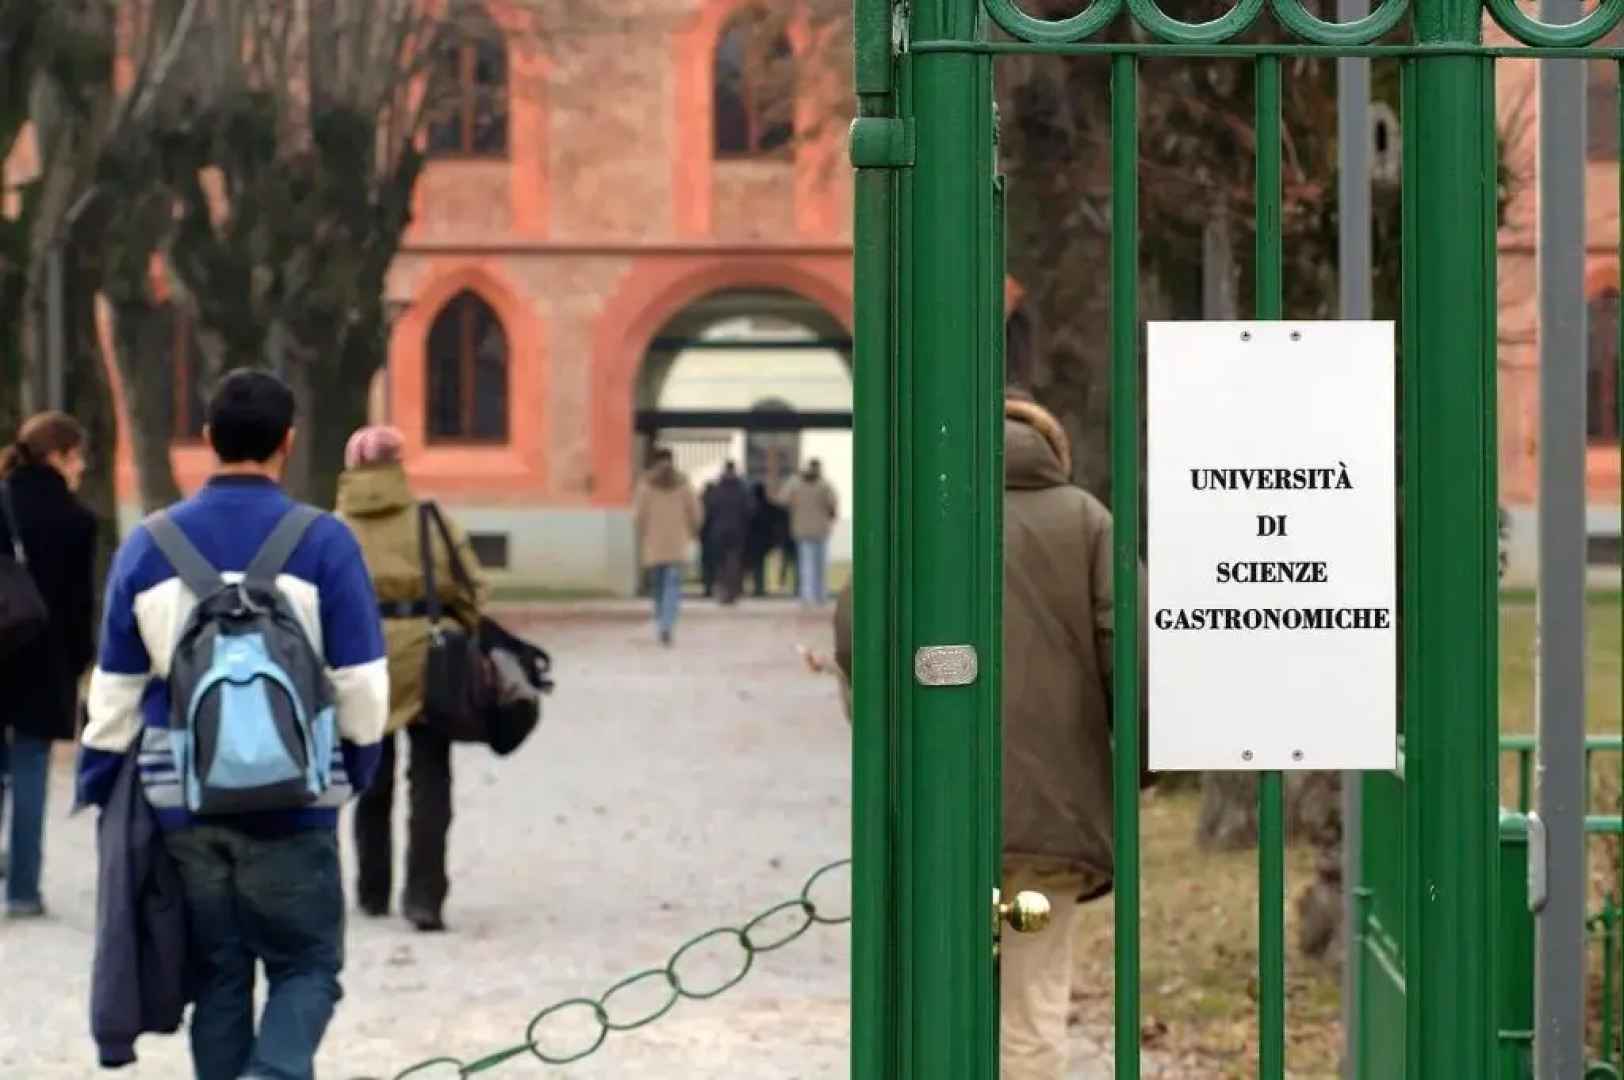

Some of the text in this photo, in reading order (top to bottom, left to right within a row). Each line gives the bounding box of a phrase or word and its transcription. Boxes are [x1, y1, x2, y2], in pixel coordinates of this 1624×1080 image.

[1190, 461, 1354, 491] UNIVERSITÀ
[1256, 515, 1287, 537] DI
[1216, 561, 1328, 583] SCIENZE
[1155, 608, 1390, 630] GASTRONOMICHE
